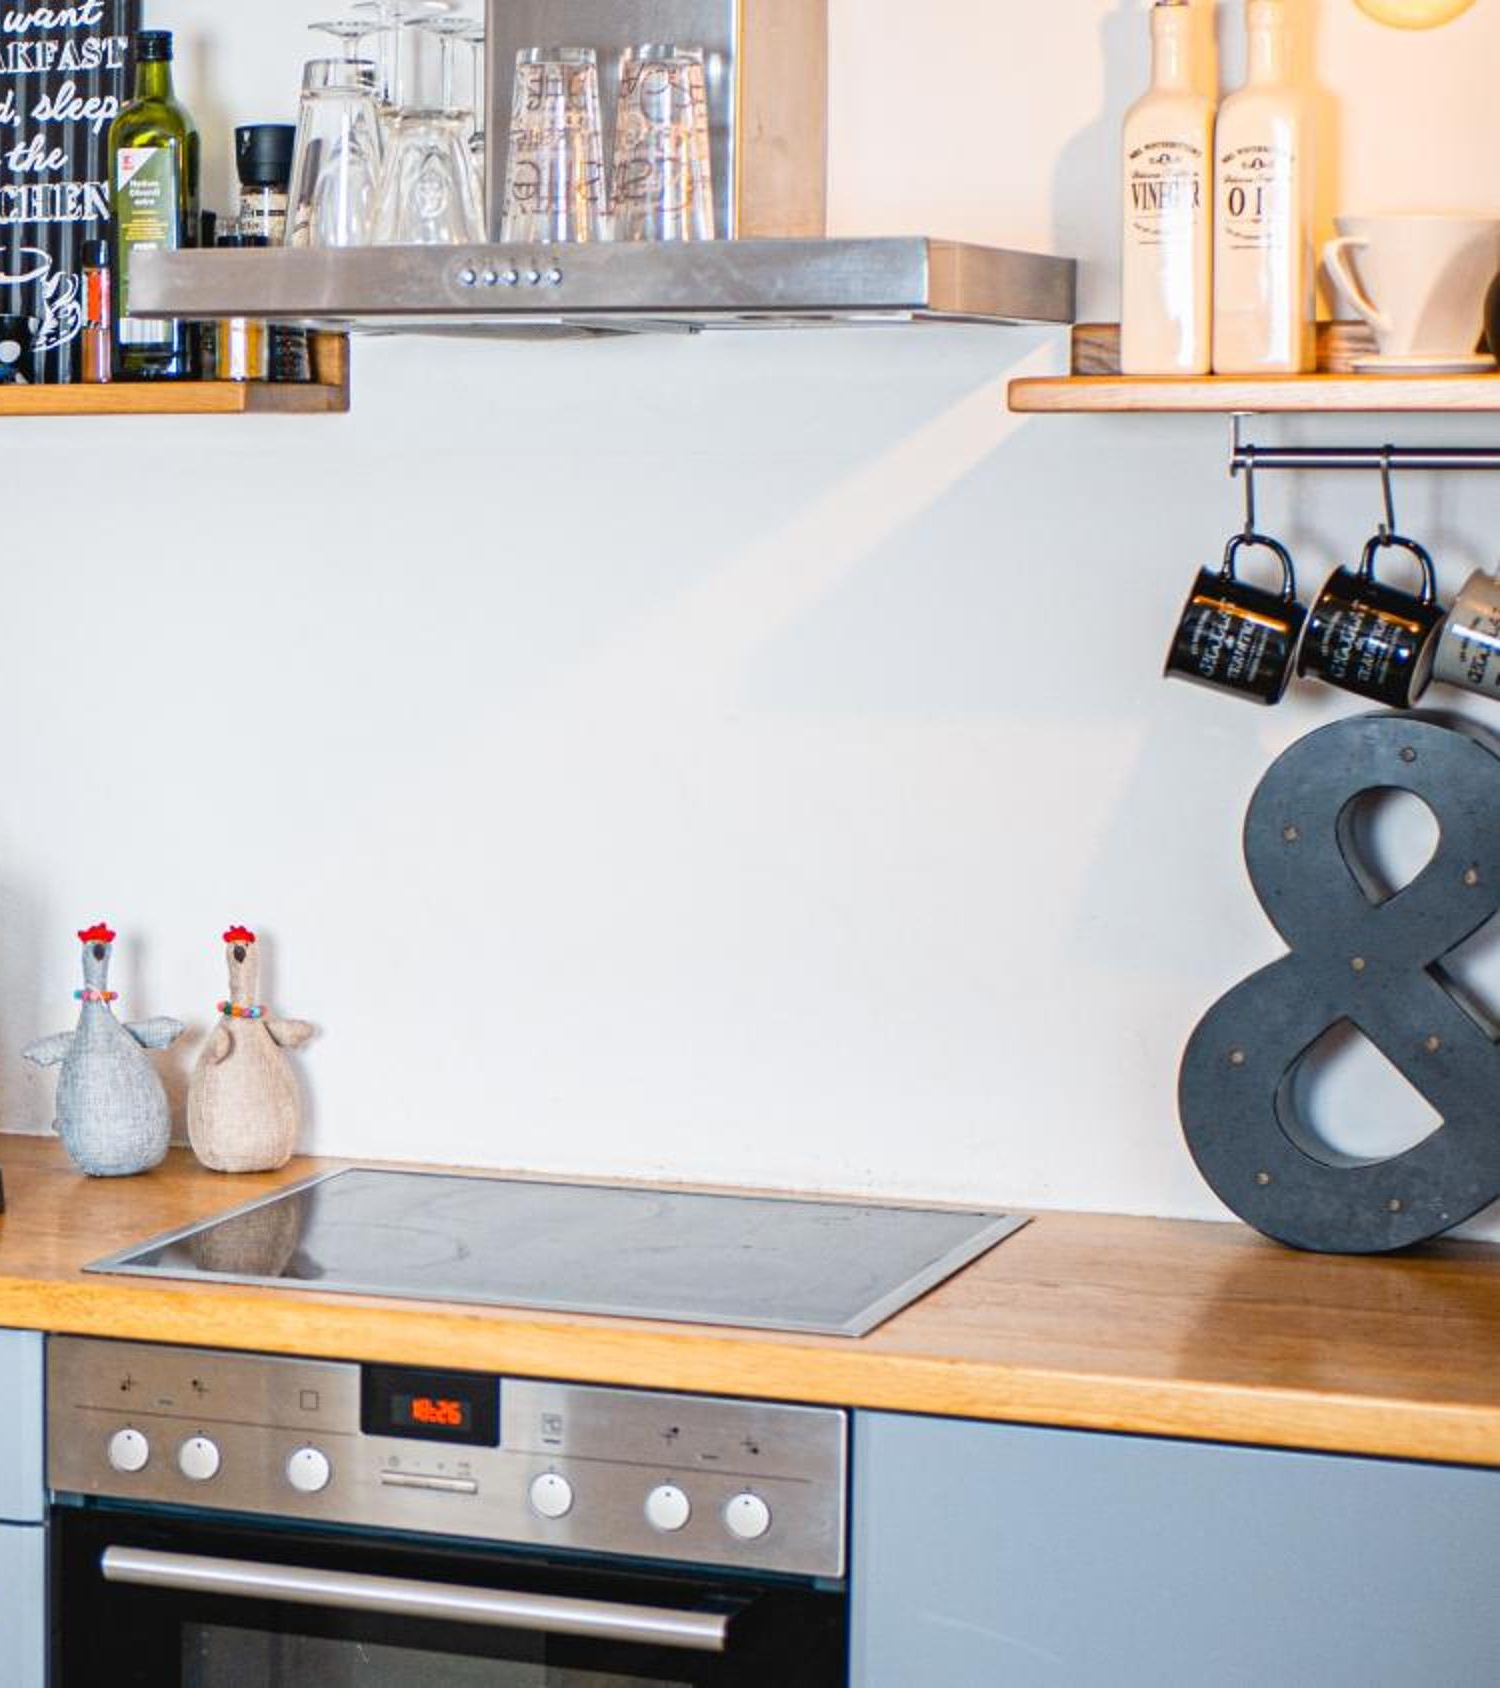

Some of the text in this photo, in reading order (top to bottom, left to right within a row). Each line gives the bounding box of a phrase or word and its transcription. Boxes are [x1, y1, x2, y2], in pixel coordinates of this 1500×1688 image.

[3, 0, 104, 33] want
[30, 80, 119, 135] sleep
[4, 133, 69, 172] the
